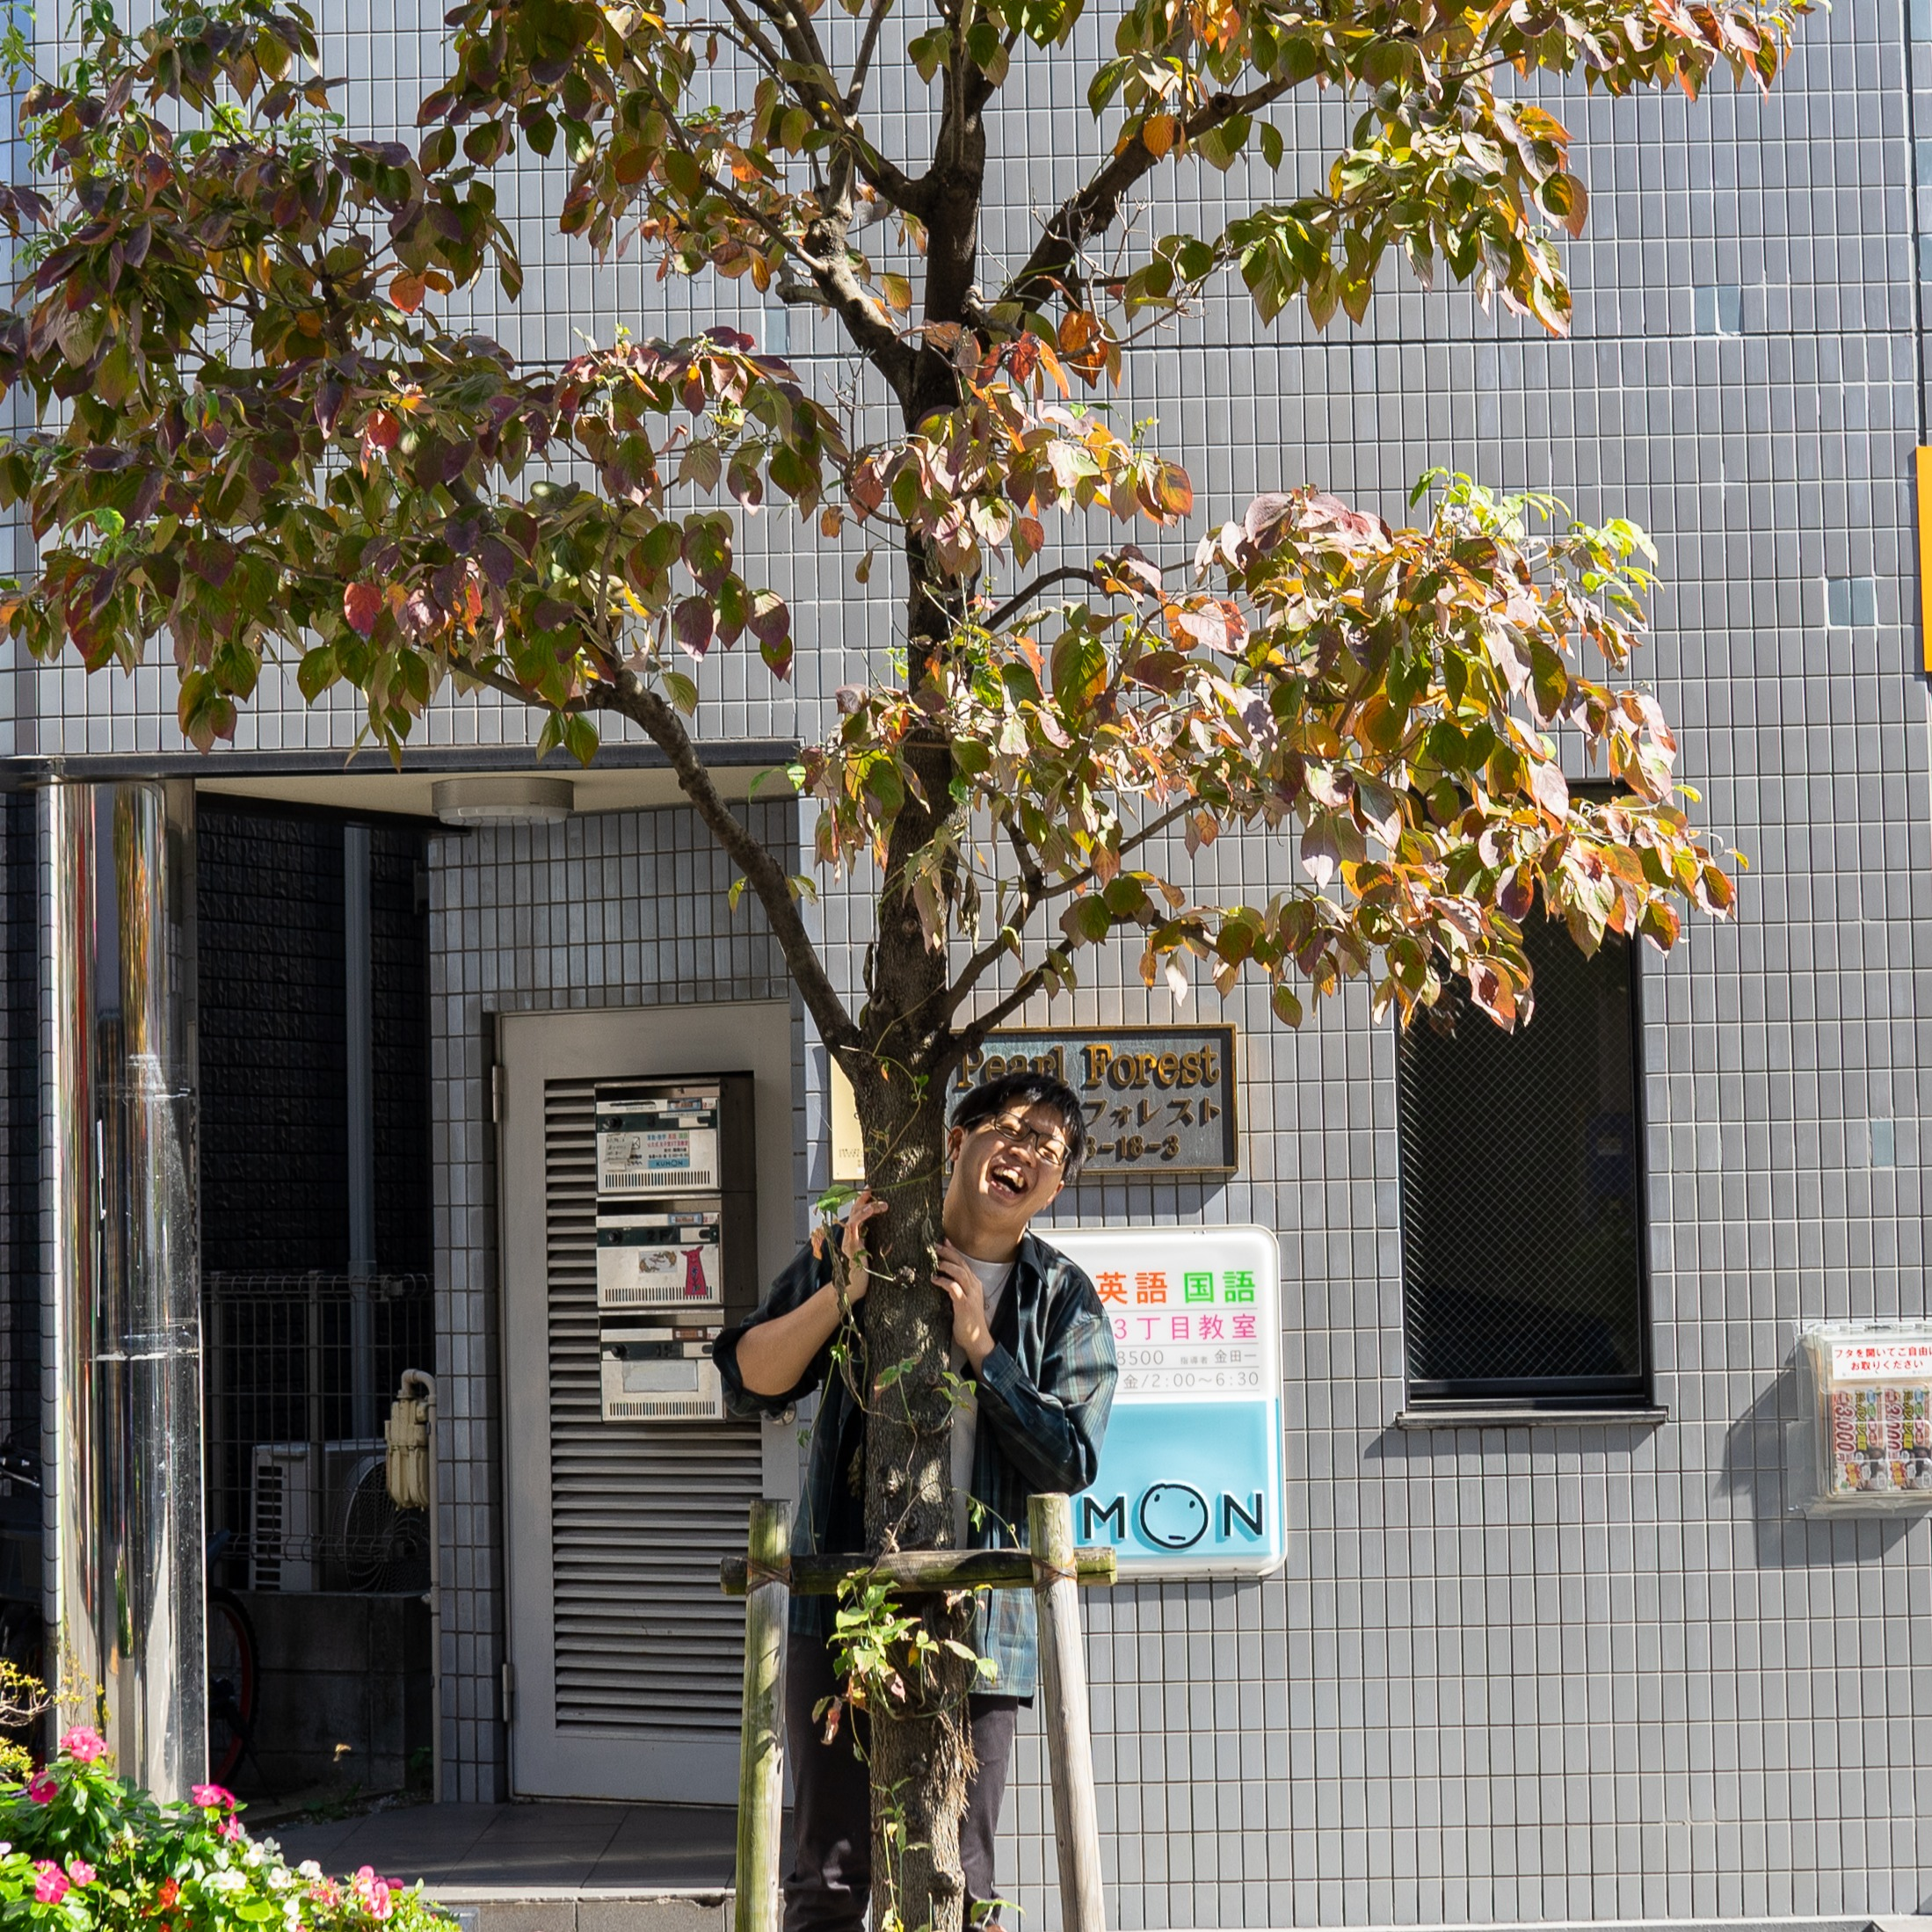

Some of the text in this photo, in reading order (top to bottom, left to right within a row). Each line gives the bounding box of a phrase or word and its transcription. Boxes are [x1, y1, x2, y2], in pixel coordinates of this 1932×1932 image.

[957, 1042, 1221, 1087] Pearl Forest
[1082, 1096, 1221, 1128] フォレスト
[1095, 1270, 1256, 1304] 英語 国語
[1114, 1313, 1258, 1340] 3丁目教室
[1117, 1348, 1257, 1365] 8500 指導者 金田一
[1851, 1359, 1924, 1371] お取りください
